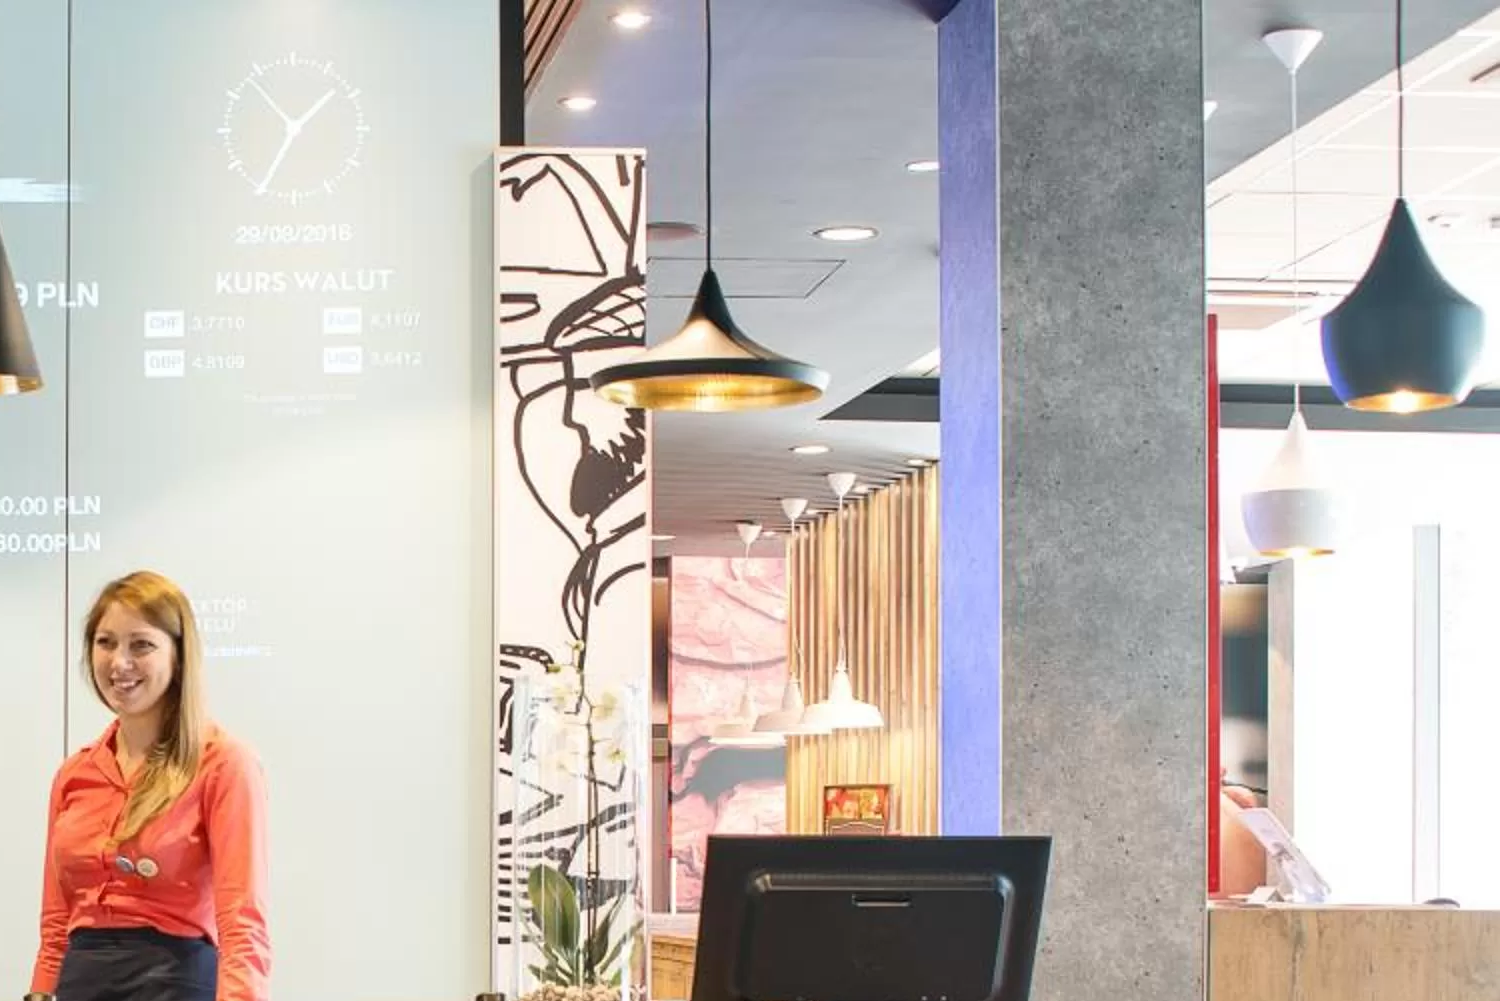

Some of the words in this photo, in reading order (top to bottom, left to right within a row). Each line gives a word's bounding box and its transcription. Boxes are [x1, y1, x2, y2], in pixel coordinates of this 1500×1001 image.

[37, 281, 100, 308] PLN
[215, 271, 288, 295] KURS
[294, 267, 395, 292] WALUT
[53, 495, 101, 516] PLN
